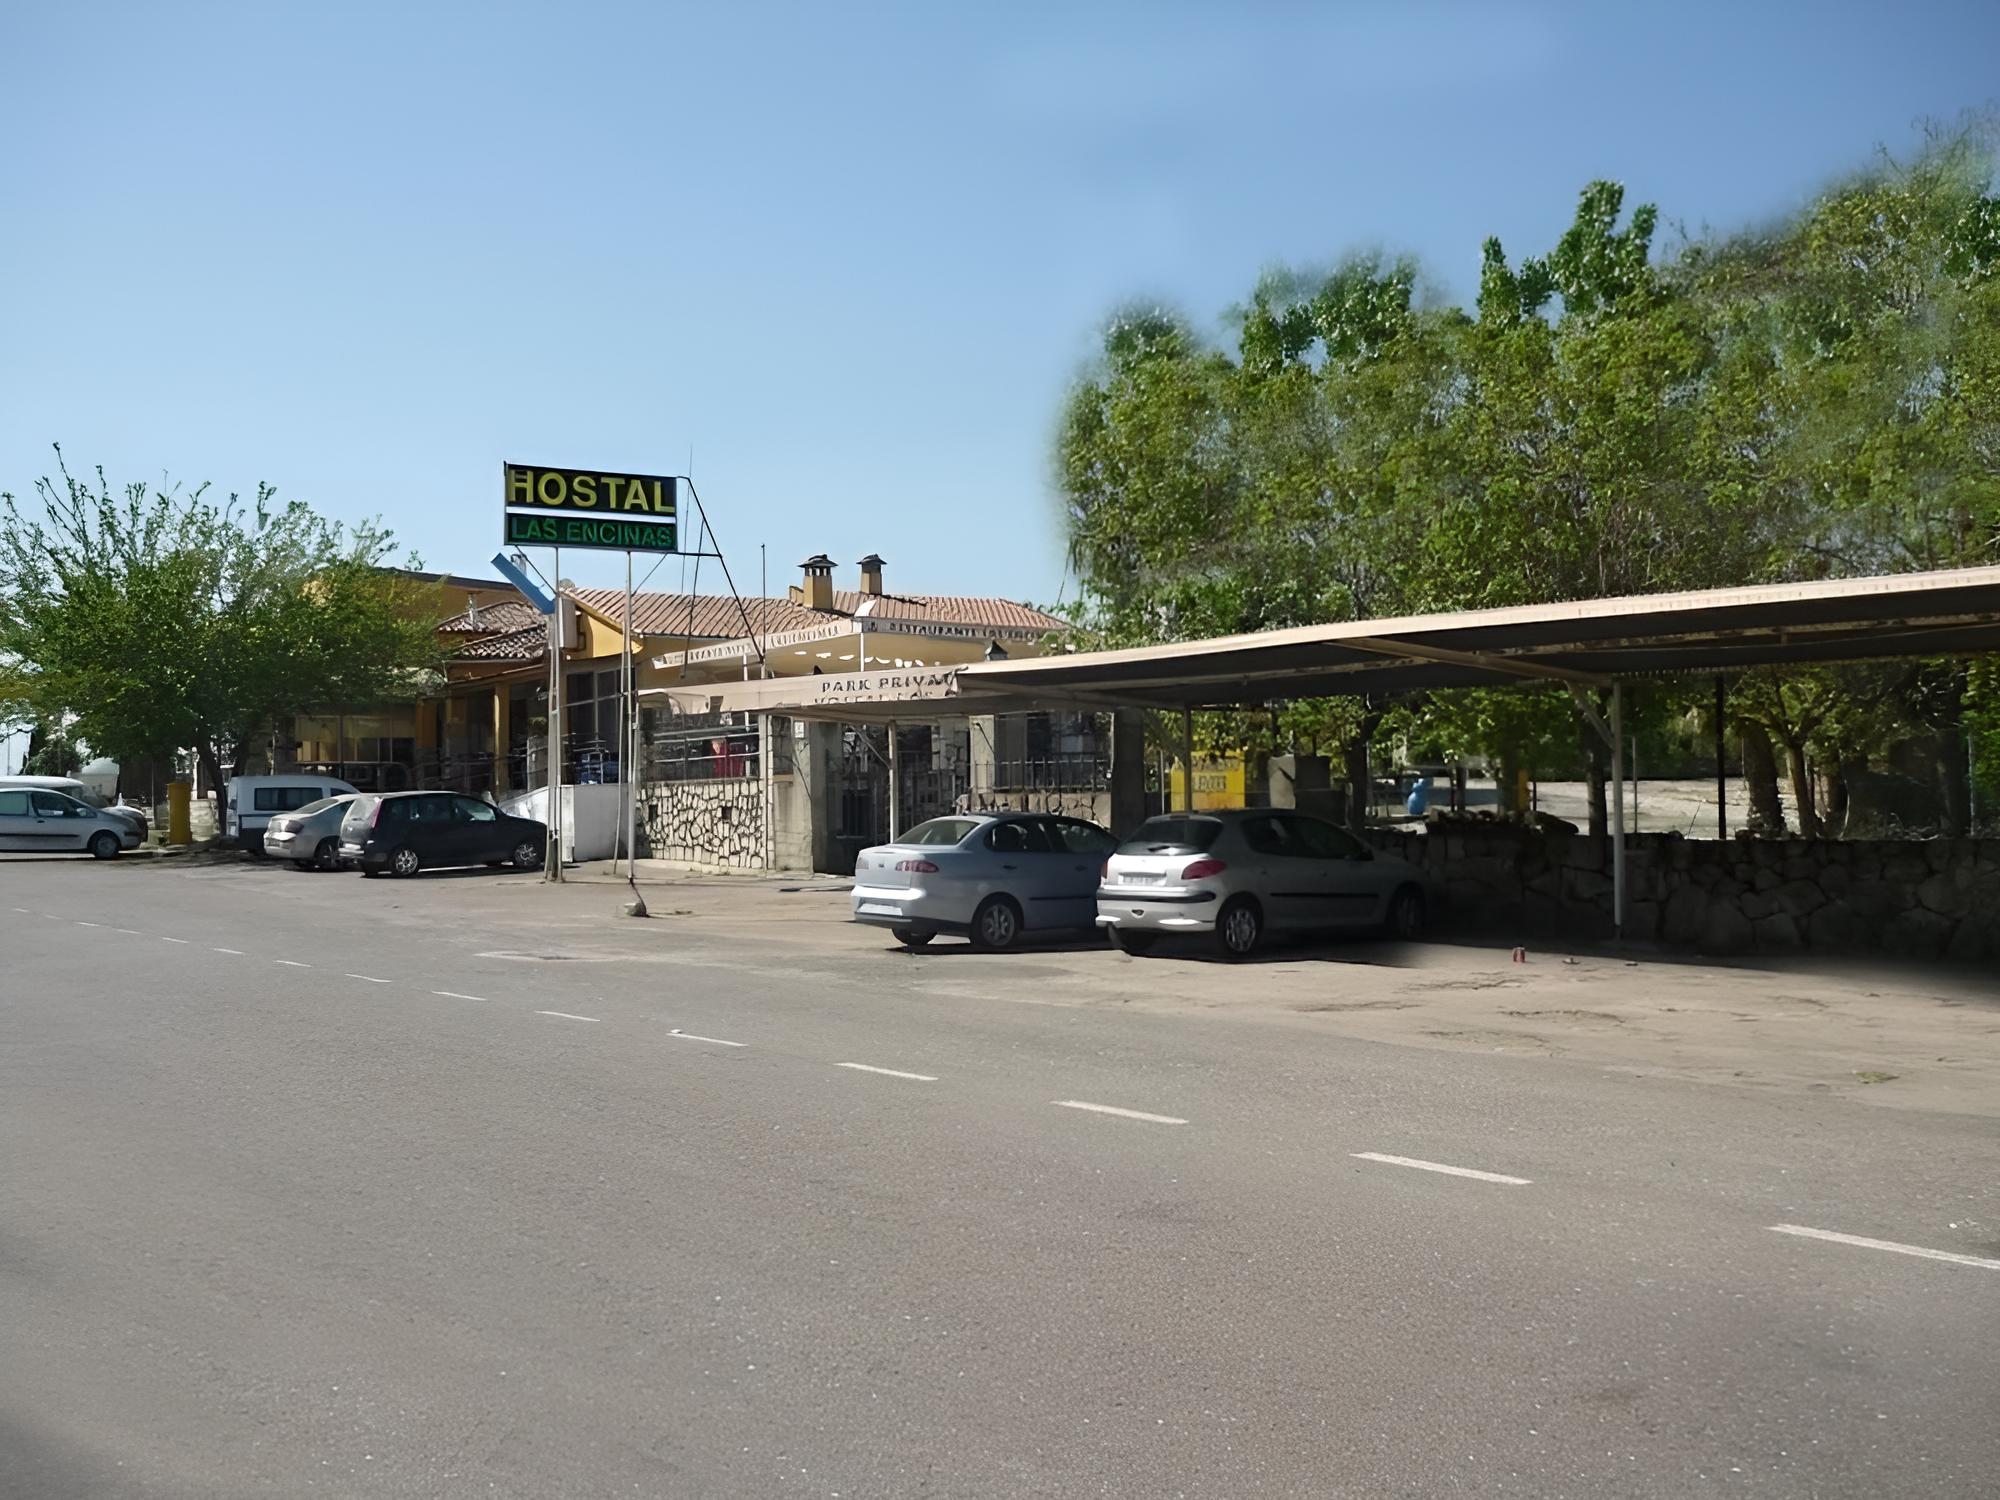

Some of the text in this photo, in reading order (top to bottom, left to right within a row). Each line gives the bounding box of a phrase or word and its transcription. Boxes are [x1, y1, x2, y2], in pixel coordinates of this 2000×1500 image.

[508, 469, 676, 513] HOSTAL
[511, 516, 673, 547] LAS ENCINAS
[822, 679, 871, 693] PARK
